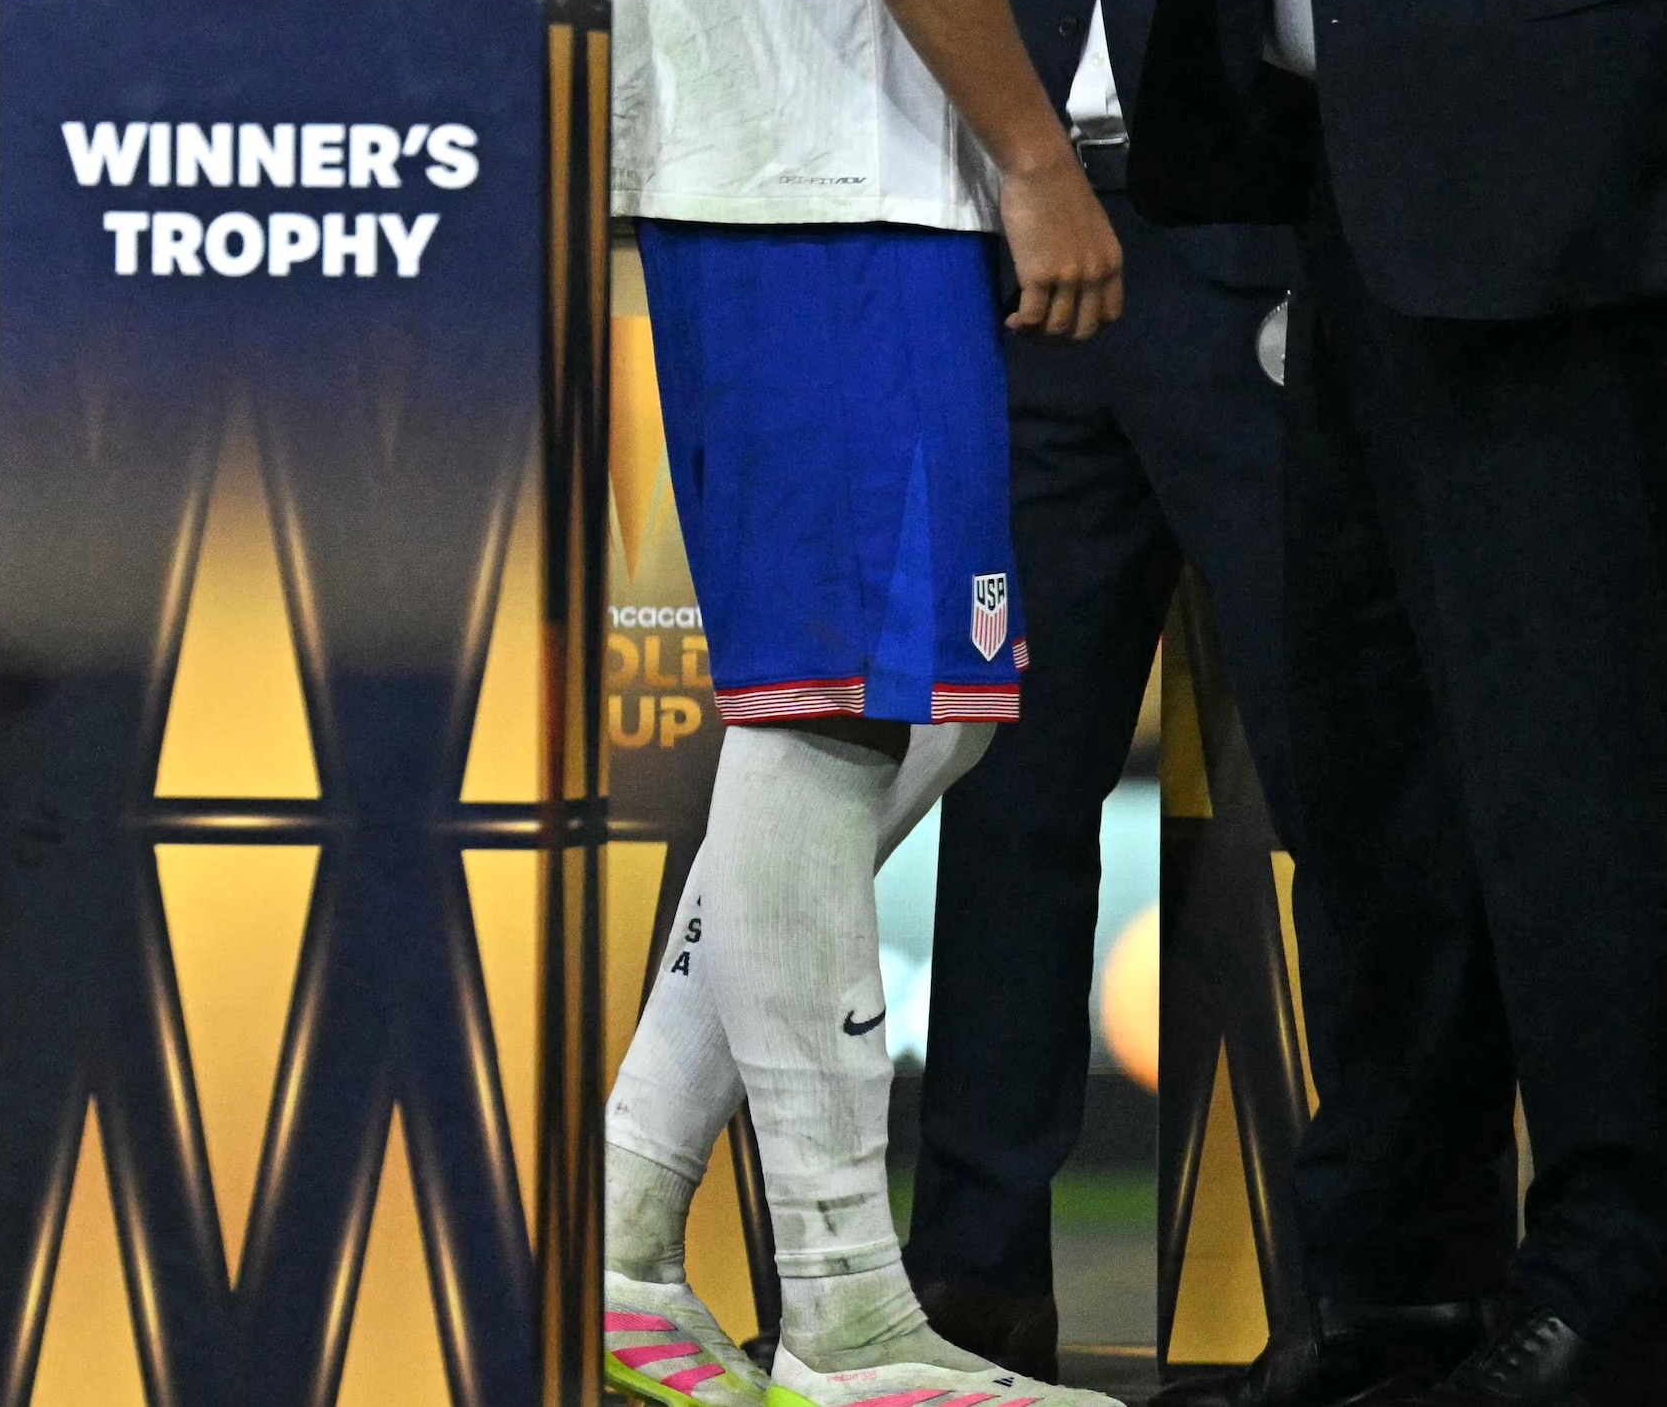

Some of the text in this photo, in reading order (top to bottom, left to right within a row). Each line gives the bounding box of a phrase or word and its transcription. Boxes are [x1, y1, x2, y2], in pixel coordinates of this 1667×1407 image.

[61, 120, 480, 190] WINNER'S
[102, 211, 442, 278] TROPHY
[976, 577, 1005, 611] USA
[607, 695, 702, 750] UP
[671, 895, 702, 976] SA
